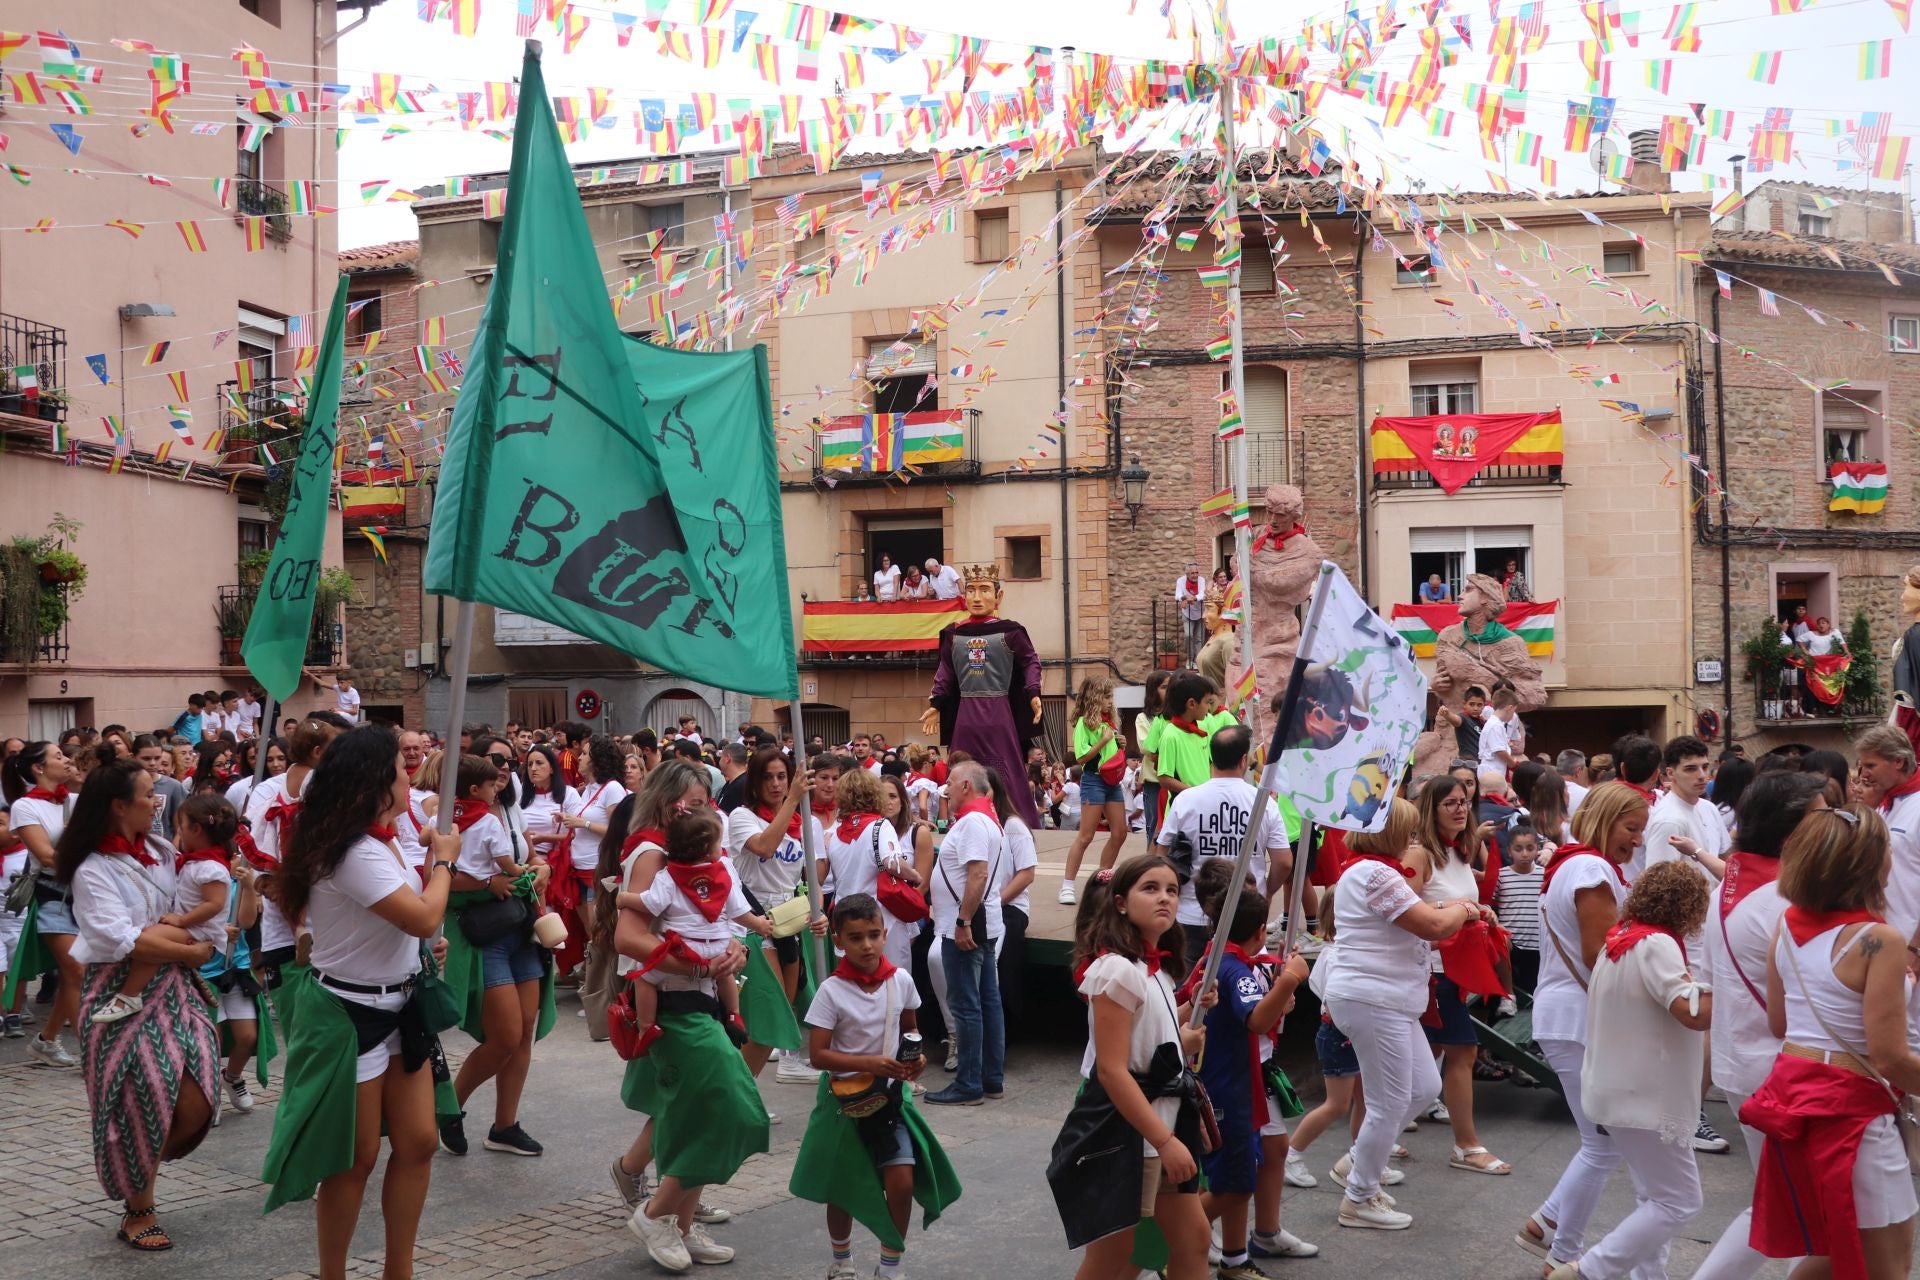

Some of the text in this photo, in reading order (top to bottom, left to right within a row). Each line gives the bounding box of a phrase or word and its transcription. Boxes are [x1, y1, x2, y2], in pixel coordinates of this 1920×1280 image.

[60, 679, 68, 695] 9
[808, 685, 813, 693] 7
[1200, 835, 1257, 856] BLAN
